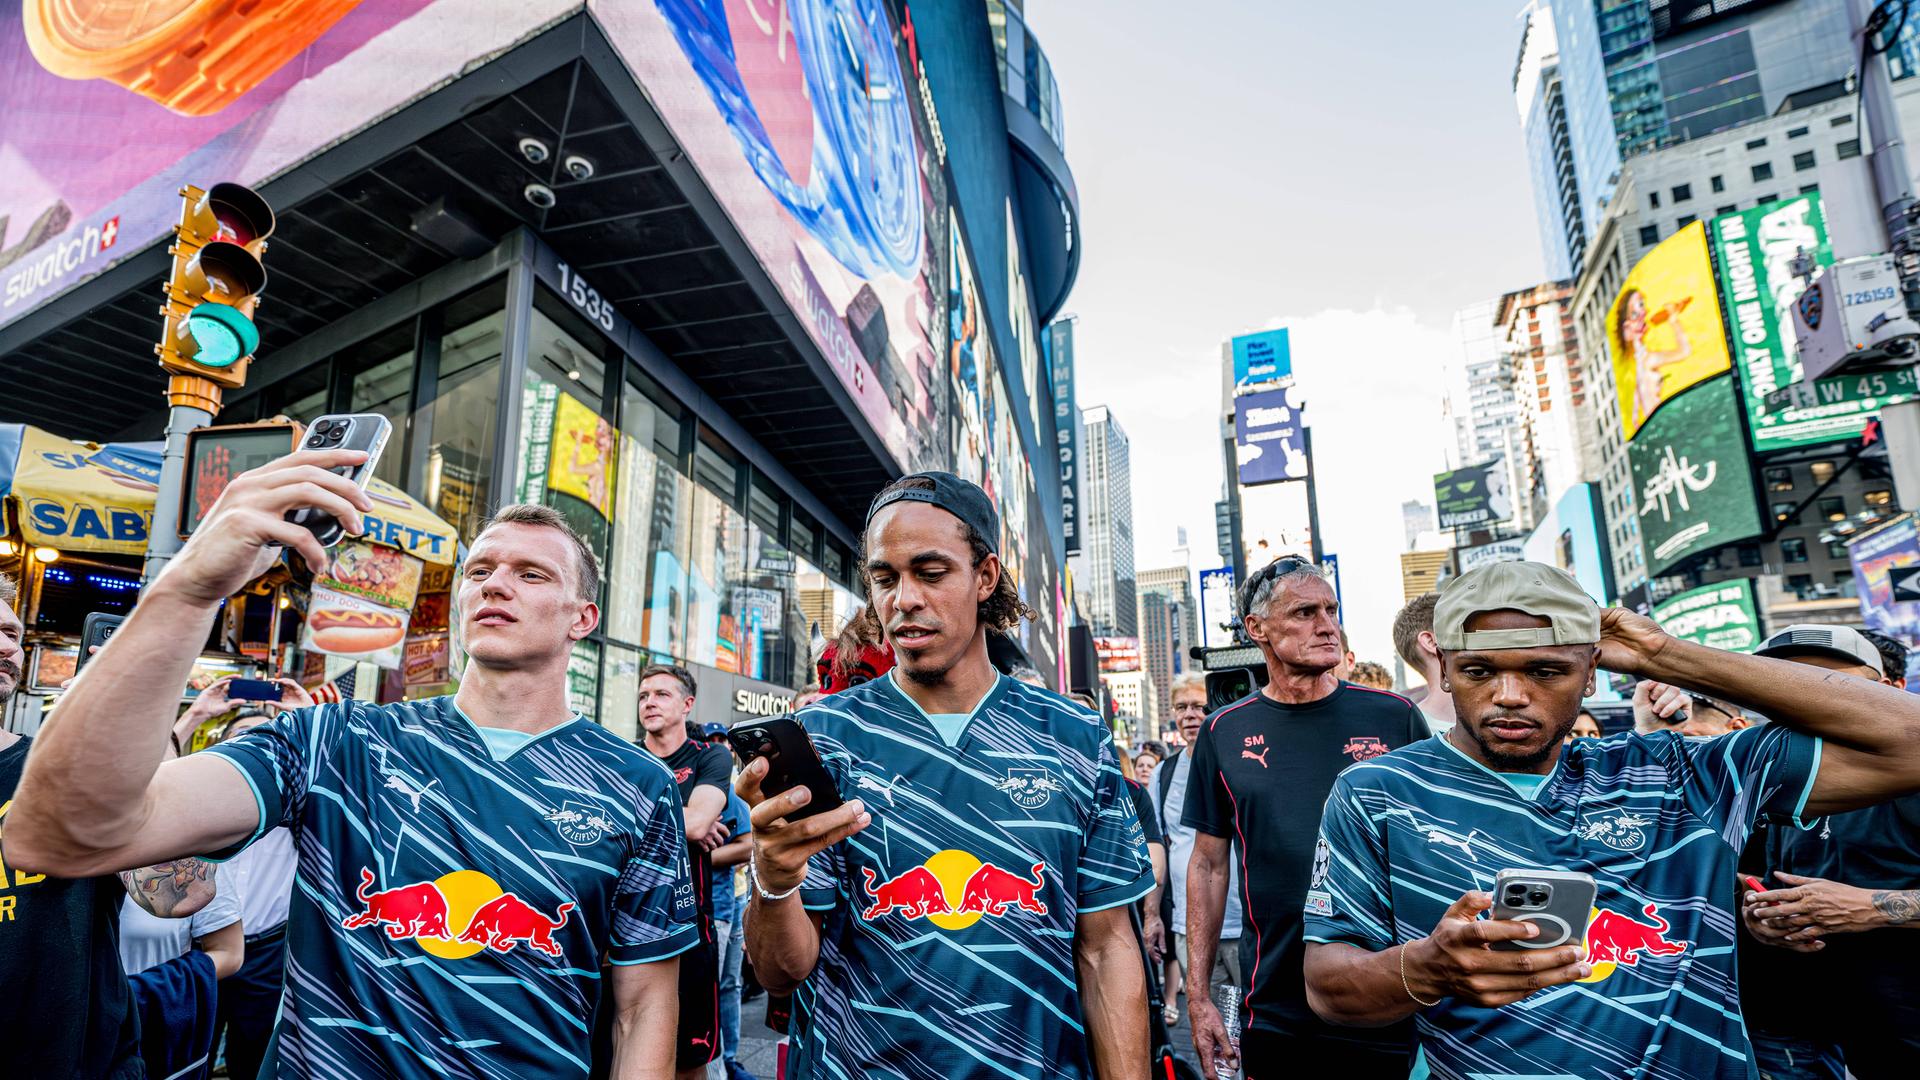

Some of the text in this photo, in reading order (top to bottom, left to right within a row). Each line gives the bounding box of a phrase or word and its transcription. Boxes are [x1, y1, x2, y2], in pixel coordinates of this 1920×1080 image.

[4, 226, 100, 307] swatch
[557, 262, 615, 332] 1535
[1719, 214, 1778, 399] ONLY ONE NIGHT IN
[1845, 286, 1896, 306] 726159
[790, 261, 856, 381] swatch
[1820, 370, 1915, 402] W 45 St
[1053, 331, 1075, 538] TIMES SQUARE
[33, 503, 152, 542] SAB
[362, 515, 446, 554] RETT
[316, 591, 361, 610] HOT DOG
[408, 644, 424, 656] HOT
[737, 689, 792, 716] swatch
[1244, 735, 1265, 747] SM
[1022, 792, 1048, 806] LEIPZIG
[570, 829, 598, 842] LEIPZIG
[1619, 831, 1641, 847] LEIPZIG
